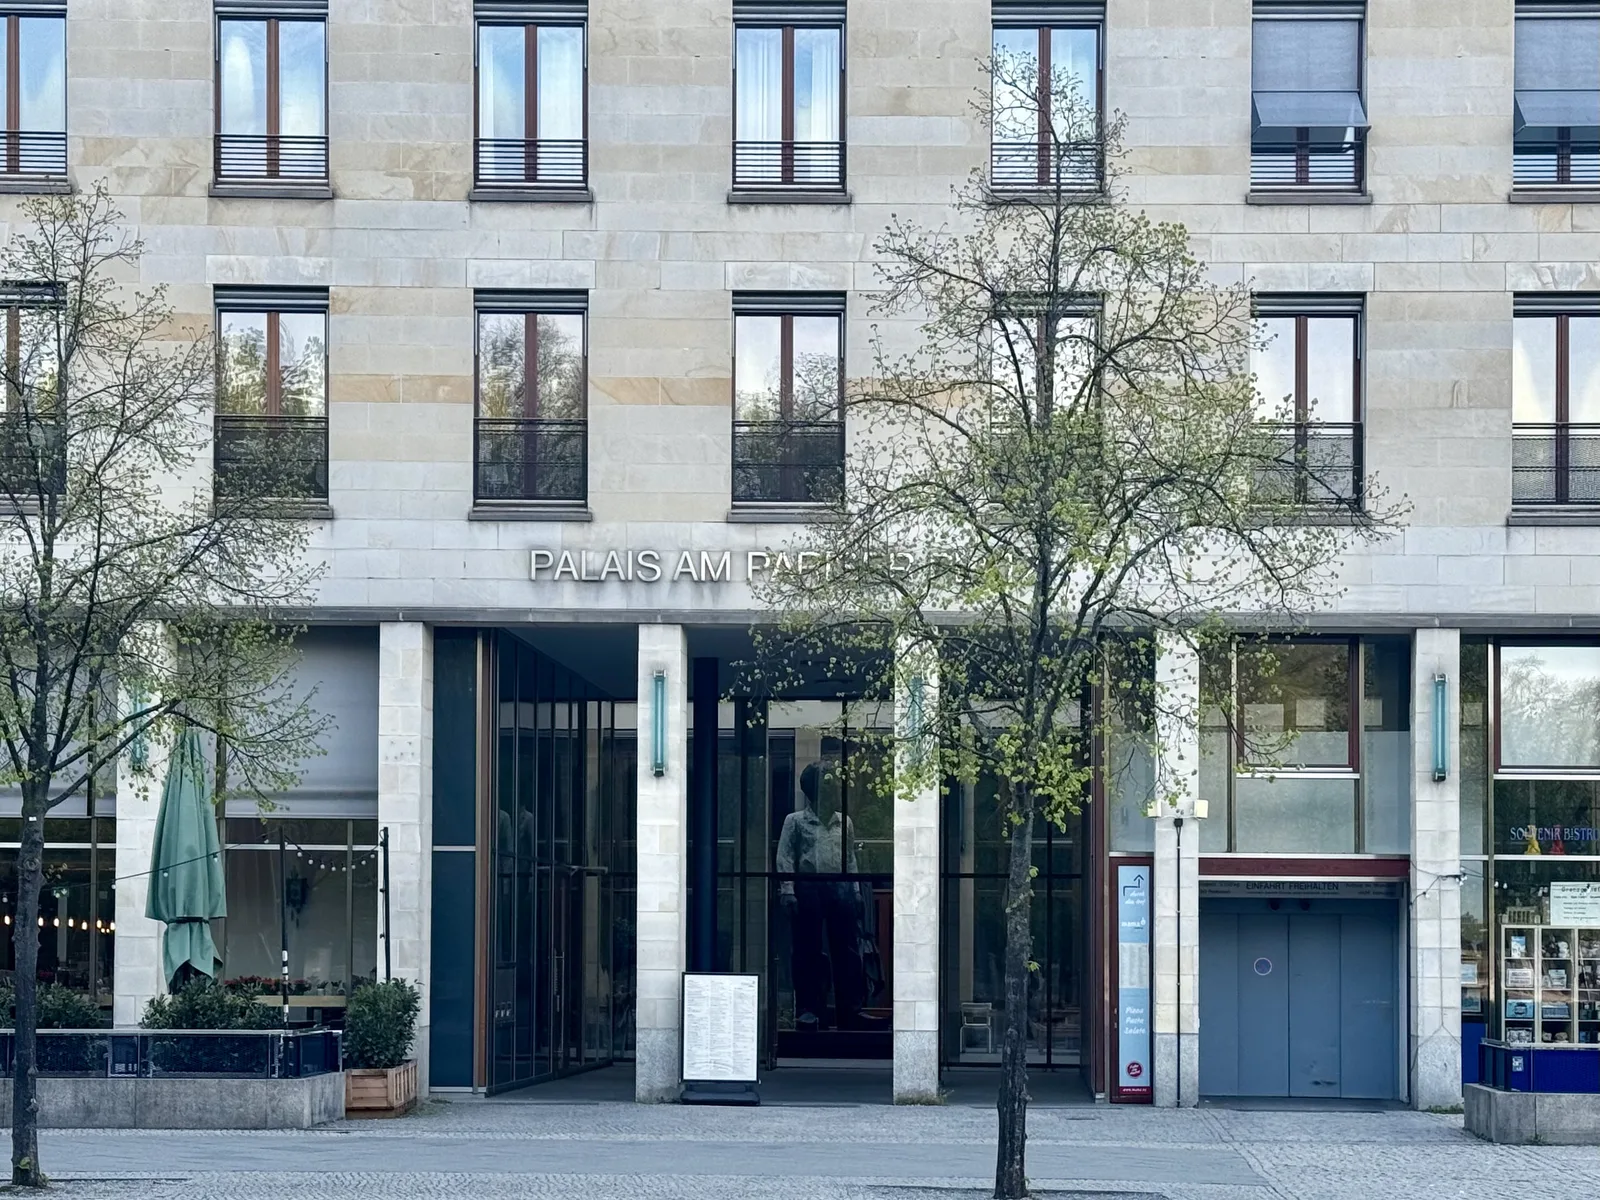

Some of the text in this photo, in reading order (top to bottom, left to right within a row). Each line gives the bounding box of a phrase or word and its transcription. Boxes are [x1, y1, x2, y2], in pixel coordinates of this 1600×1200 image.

[530, 550, 662, 582] PALAIS
[673, 550, 730, 582] AM
[747, 550, 915, 582] PARIR
[1246, 882, 1286, 890] EINFAHRT
[1289, 882, 1339, 891] FREIHALTEN
[1125, 1006, 1144, 1015] Pizza
